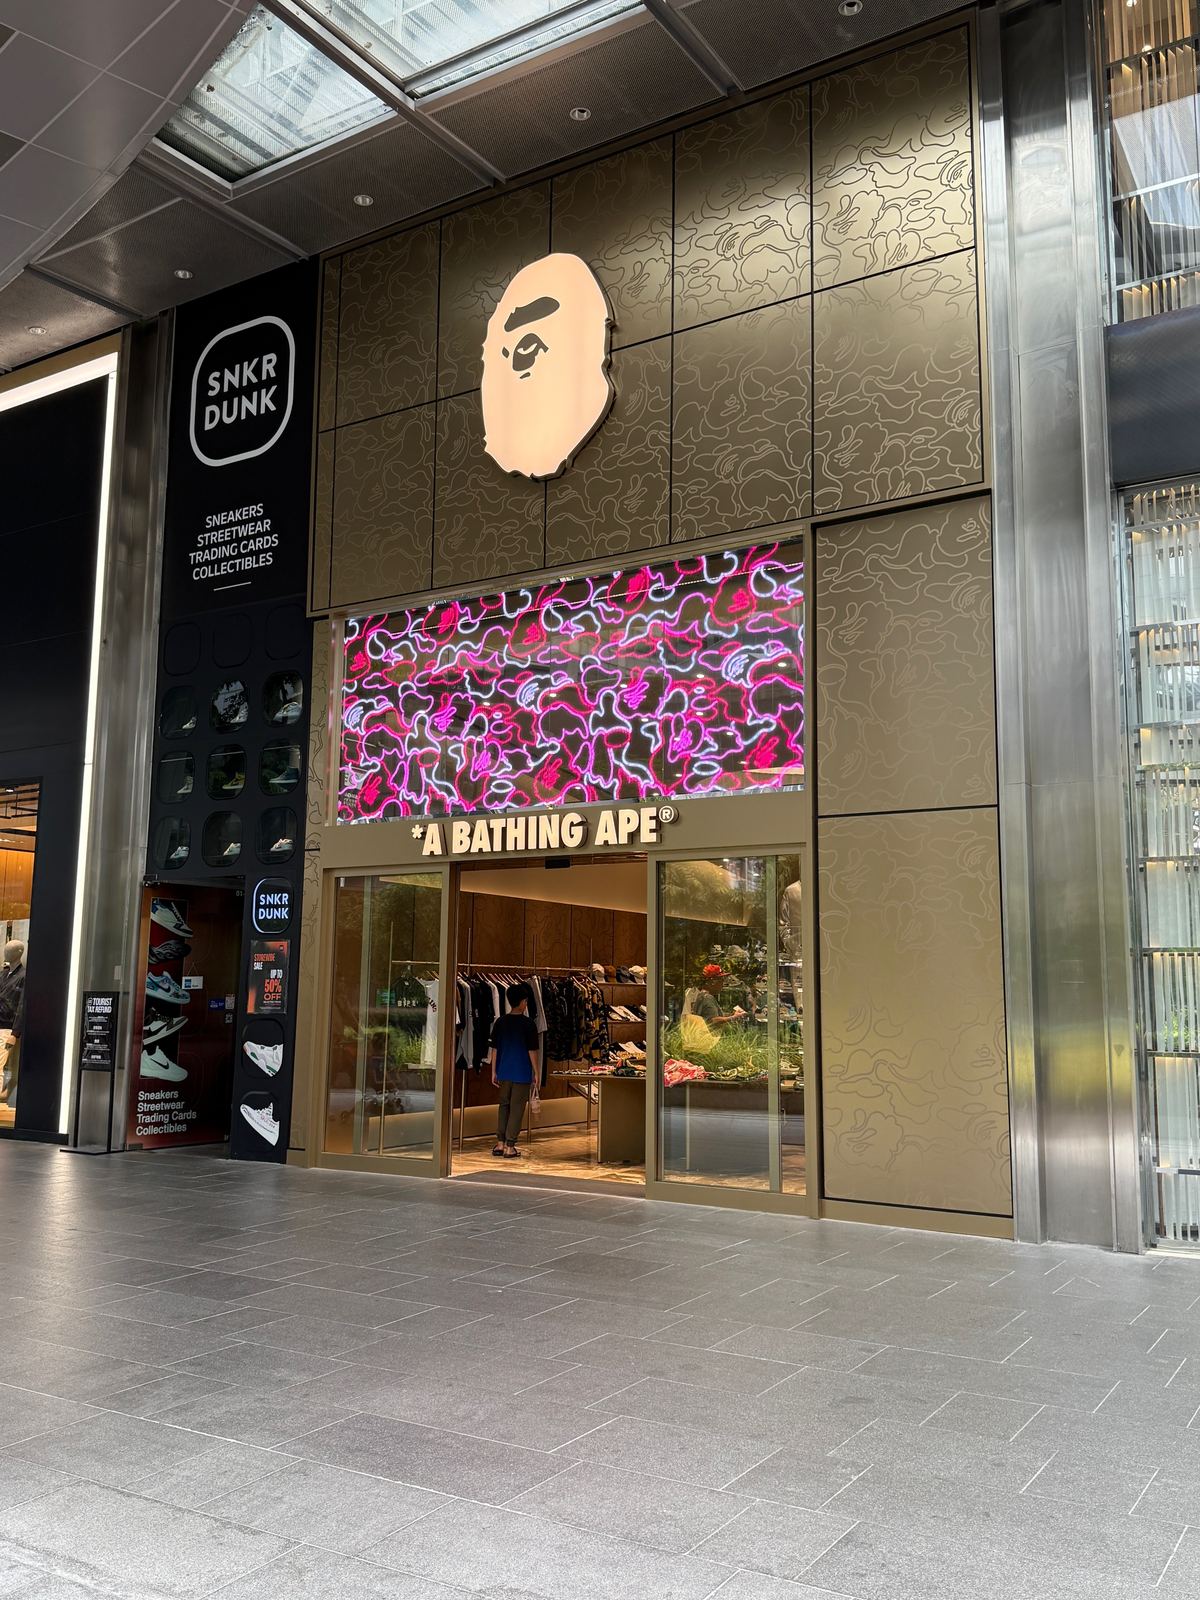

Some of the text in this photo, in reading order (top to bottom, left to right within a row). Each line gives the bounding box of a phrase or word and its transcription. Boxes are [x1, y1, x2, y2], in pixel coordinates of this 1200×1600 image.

[207, 353, 277, 397] SNKR
[204, 385, 278, 431] DUNK
[205, 503, 264, 529] SNEAKERS
[197, 519, 271, 547] STREETWEAR
[189, 534, 279, 565] TRADING CARDS
[192, 552, 273, 580] COLLECTIBLES
[452, 812, 587, 854] BATHING
[259, 893, 289, 905] SNKR
[258, 907, 289, 919] DUNK
[264, 979, 282, 993] 50%
[92, 997, 113, 1006] TOURIST
[263, 993, 282, 1001] OFF
[138, 1089, 179, 1101] Sneakers
[137, 1101, 185, 1113] Streetwear
[136, 1110, 197, 1124] Trading Cards
[136, 1123, 187, 1136] Collectibles
